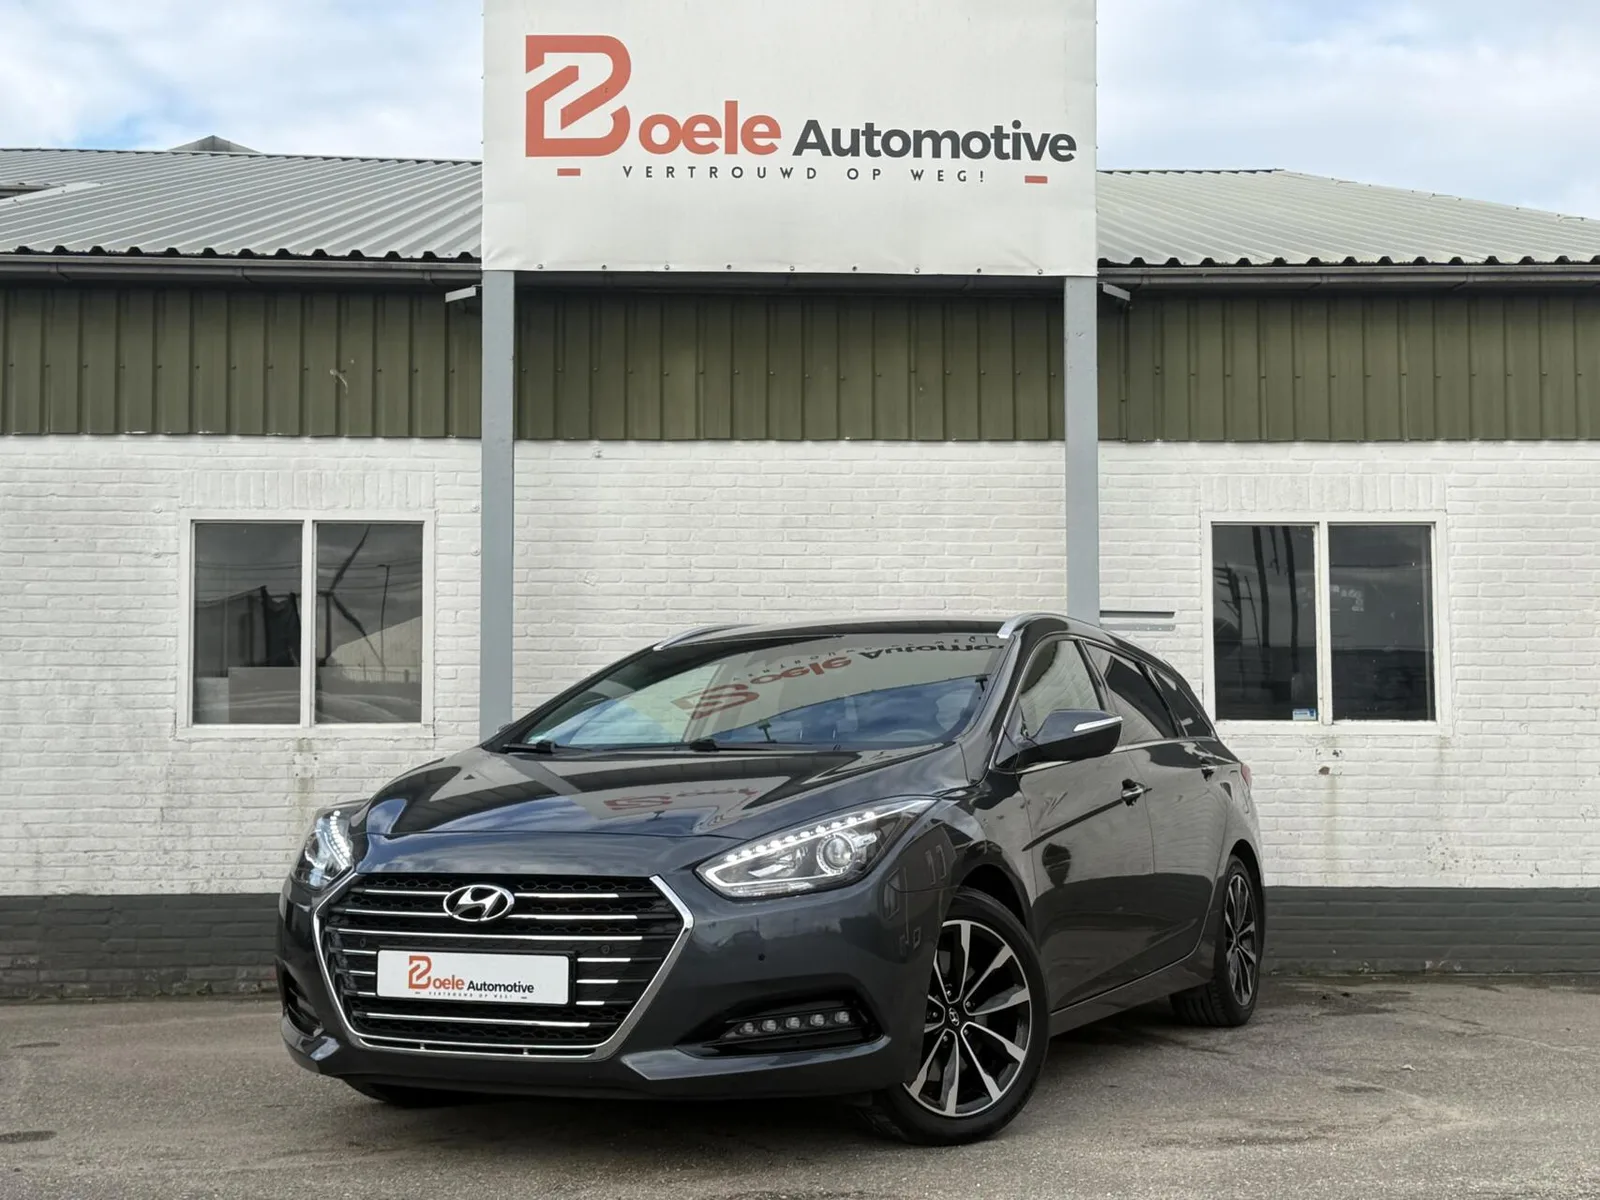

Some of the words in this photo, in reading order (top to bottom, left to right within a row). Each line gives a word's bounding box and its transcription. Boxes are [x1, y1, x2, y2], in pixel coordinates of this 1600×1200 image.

[525, 34, 782, 158] Boele
[792, 119, 1077, 163] Automotive
[622, 165, 818, 180] VERTROUWD
[846, 167, 881, 181] OP
[910, 169, 984, 183] WEG!
[408, 955, 465, 990] Boele
[466, 981, 535, 993] Automotive
